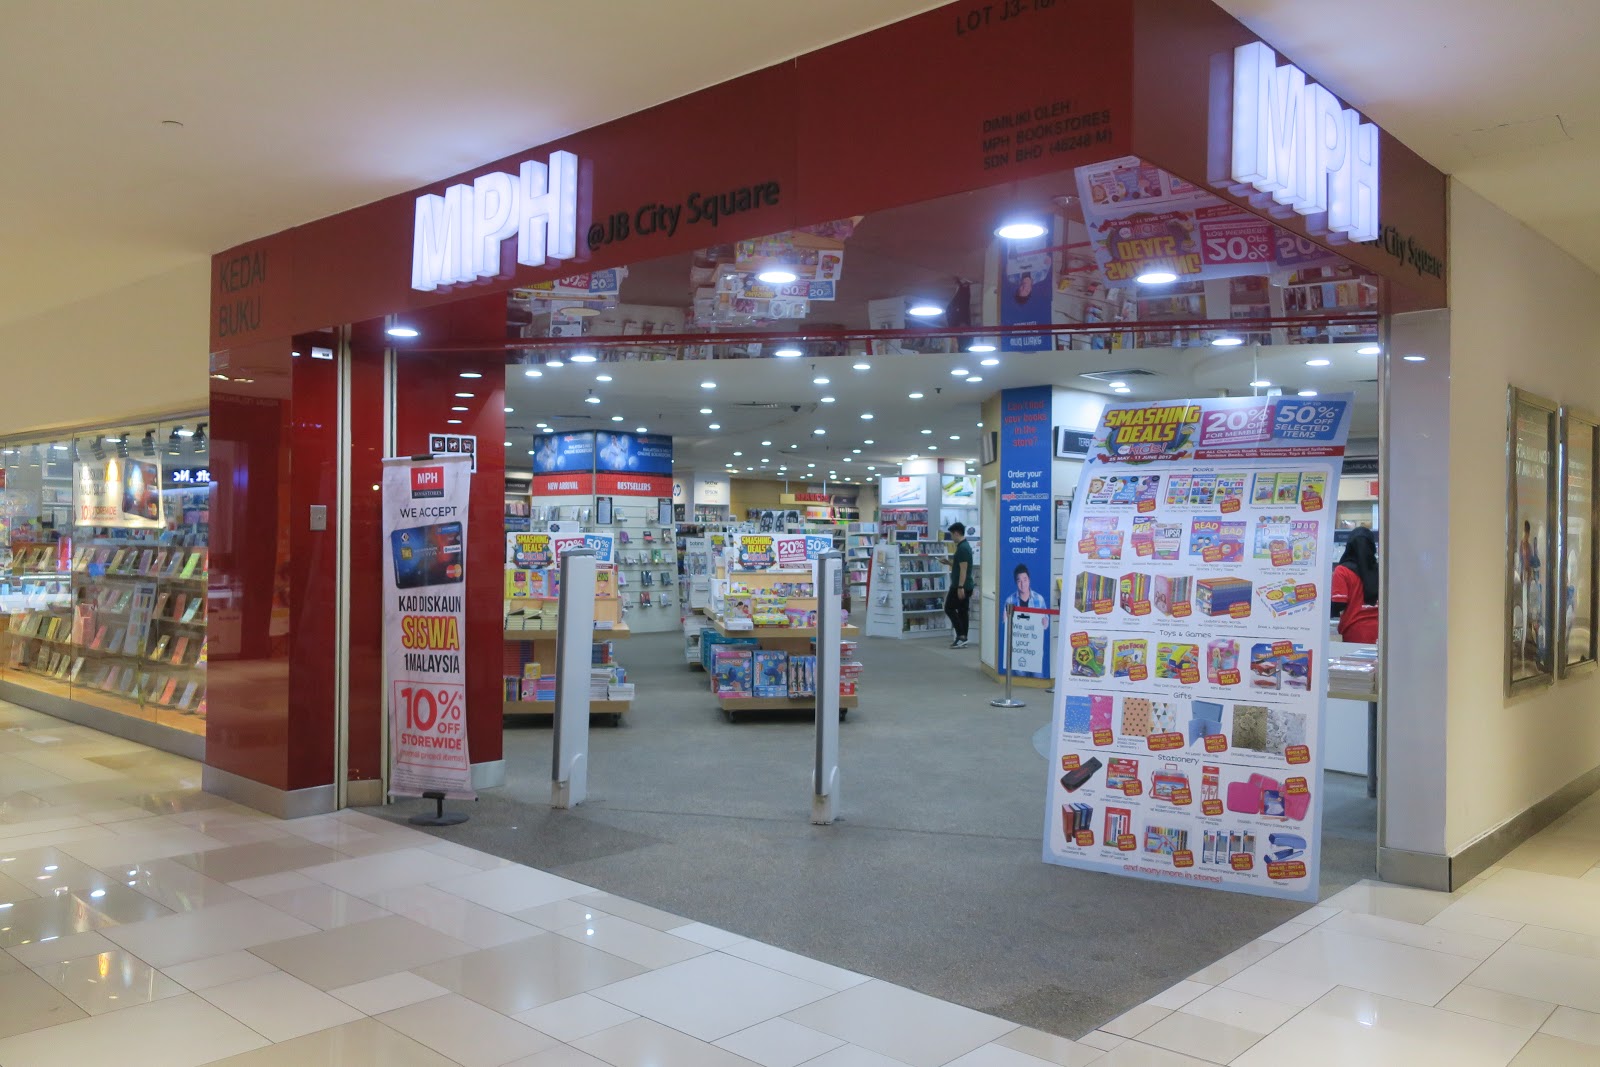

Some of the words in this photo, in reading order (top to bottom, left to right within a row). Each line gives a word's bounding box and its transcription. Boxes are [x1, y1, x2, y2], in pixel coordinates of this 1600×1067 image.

[956, 5, 993, 36] LOT
[1034, 101, 1071, 121] OLEH
[983, 135, 1010, 153] MPH
[1015, 109, 1112, 144] BOOKSTORES
[1230, 41, 1379, 243] MPH
[984, 153, 1009, 171] SDN
[1015, 145, 1043, 163] BHD
[411, 150, 577, 291] MPH
[587, 211, 631, 251] @JB
[633, 203, 681, 240] City
[686, 179, 781, 225] Square
[1384, 224, 1406, 267] City
[1408, 234, 1443, 280] Square
[219, 250, 267, 293] KEDAI
[218, 297, 261, 337] BUKU
[1004, 415, 1022, 424] your
[1023, 413, 1047, 422] books
[1104, 406, 1201, 428] SMASHING
[1014, 427, 1021, 435] in
[1023, 425, 1037, 434] the
[1247, 422, 1269, 430] OFF
[1274, 424, 1330, 432] SELECTED
[1115, 423, 1177, 444] DEALS
[1206, 431, 1224, 439] FOR
[1225, 428, 1268, 437] MEMBERS
[1013, 435, 1038, 447] store?
[417, 472, 438, 485] MPH
[1007, 470, 1026, 478] Order
[1027, 471, 1042, 480] your
[547, 482, 558, 490] NEW
[617, 481, 652, 491] BESTSELLERS
[1011, 481, 1031, 489] books
[400, 507, 417, 519] WE
[419, 506, 458, 517] ACCEPT
[1009, 504, 1022, 512] and
[1010, 514, 1040, 524] payment
[1010, 524, 1031, 532] online
[1193, 521, 1219, 531] READ
[516, 534, 549, 544] SMASHING
[741, 536, 772, 545] SMASHING
[1008, 535, 1040, 544] over-the-
[522, 543, 543, 553] DEALS
[747, 544, 767, 553] DEALS
[1012, 546, 1038, 554] counter
[398, 595, 418, 612] KAD
[419, 596, 462, 613] DISKAUN
[401, 615, 460, 651] SISWA
[1012, 631, 1030, 639] eliver
[1159, 629, 1177, 638] Toys
[1015, 640, 1030, 648] your
[1012, 648, 1036, 656] oorstep
[404, 653, 460, 674] 1MALAYSIA
[1173, 692, 1192, 700] Gifts
[437, 722, 461, 735] OFF
[401, 733, 462, 751] STOREWIDE
[1157, 753, 1200, 766] Stationery
[1123, 863, 1138, 871] and
[1138, 865, 1162, 876] many
[1162, 868, 1183, 877] more
[1183, 871, 1193, 879] in
